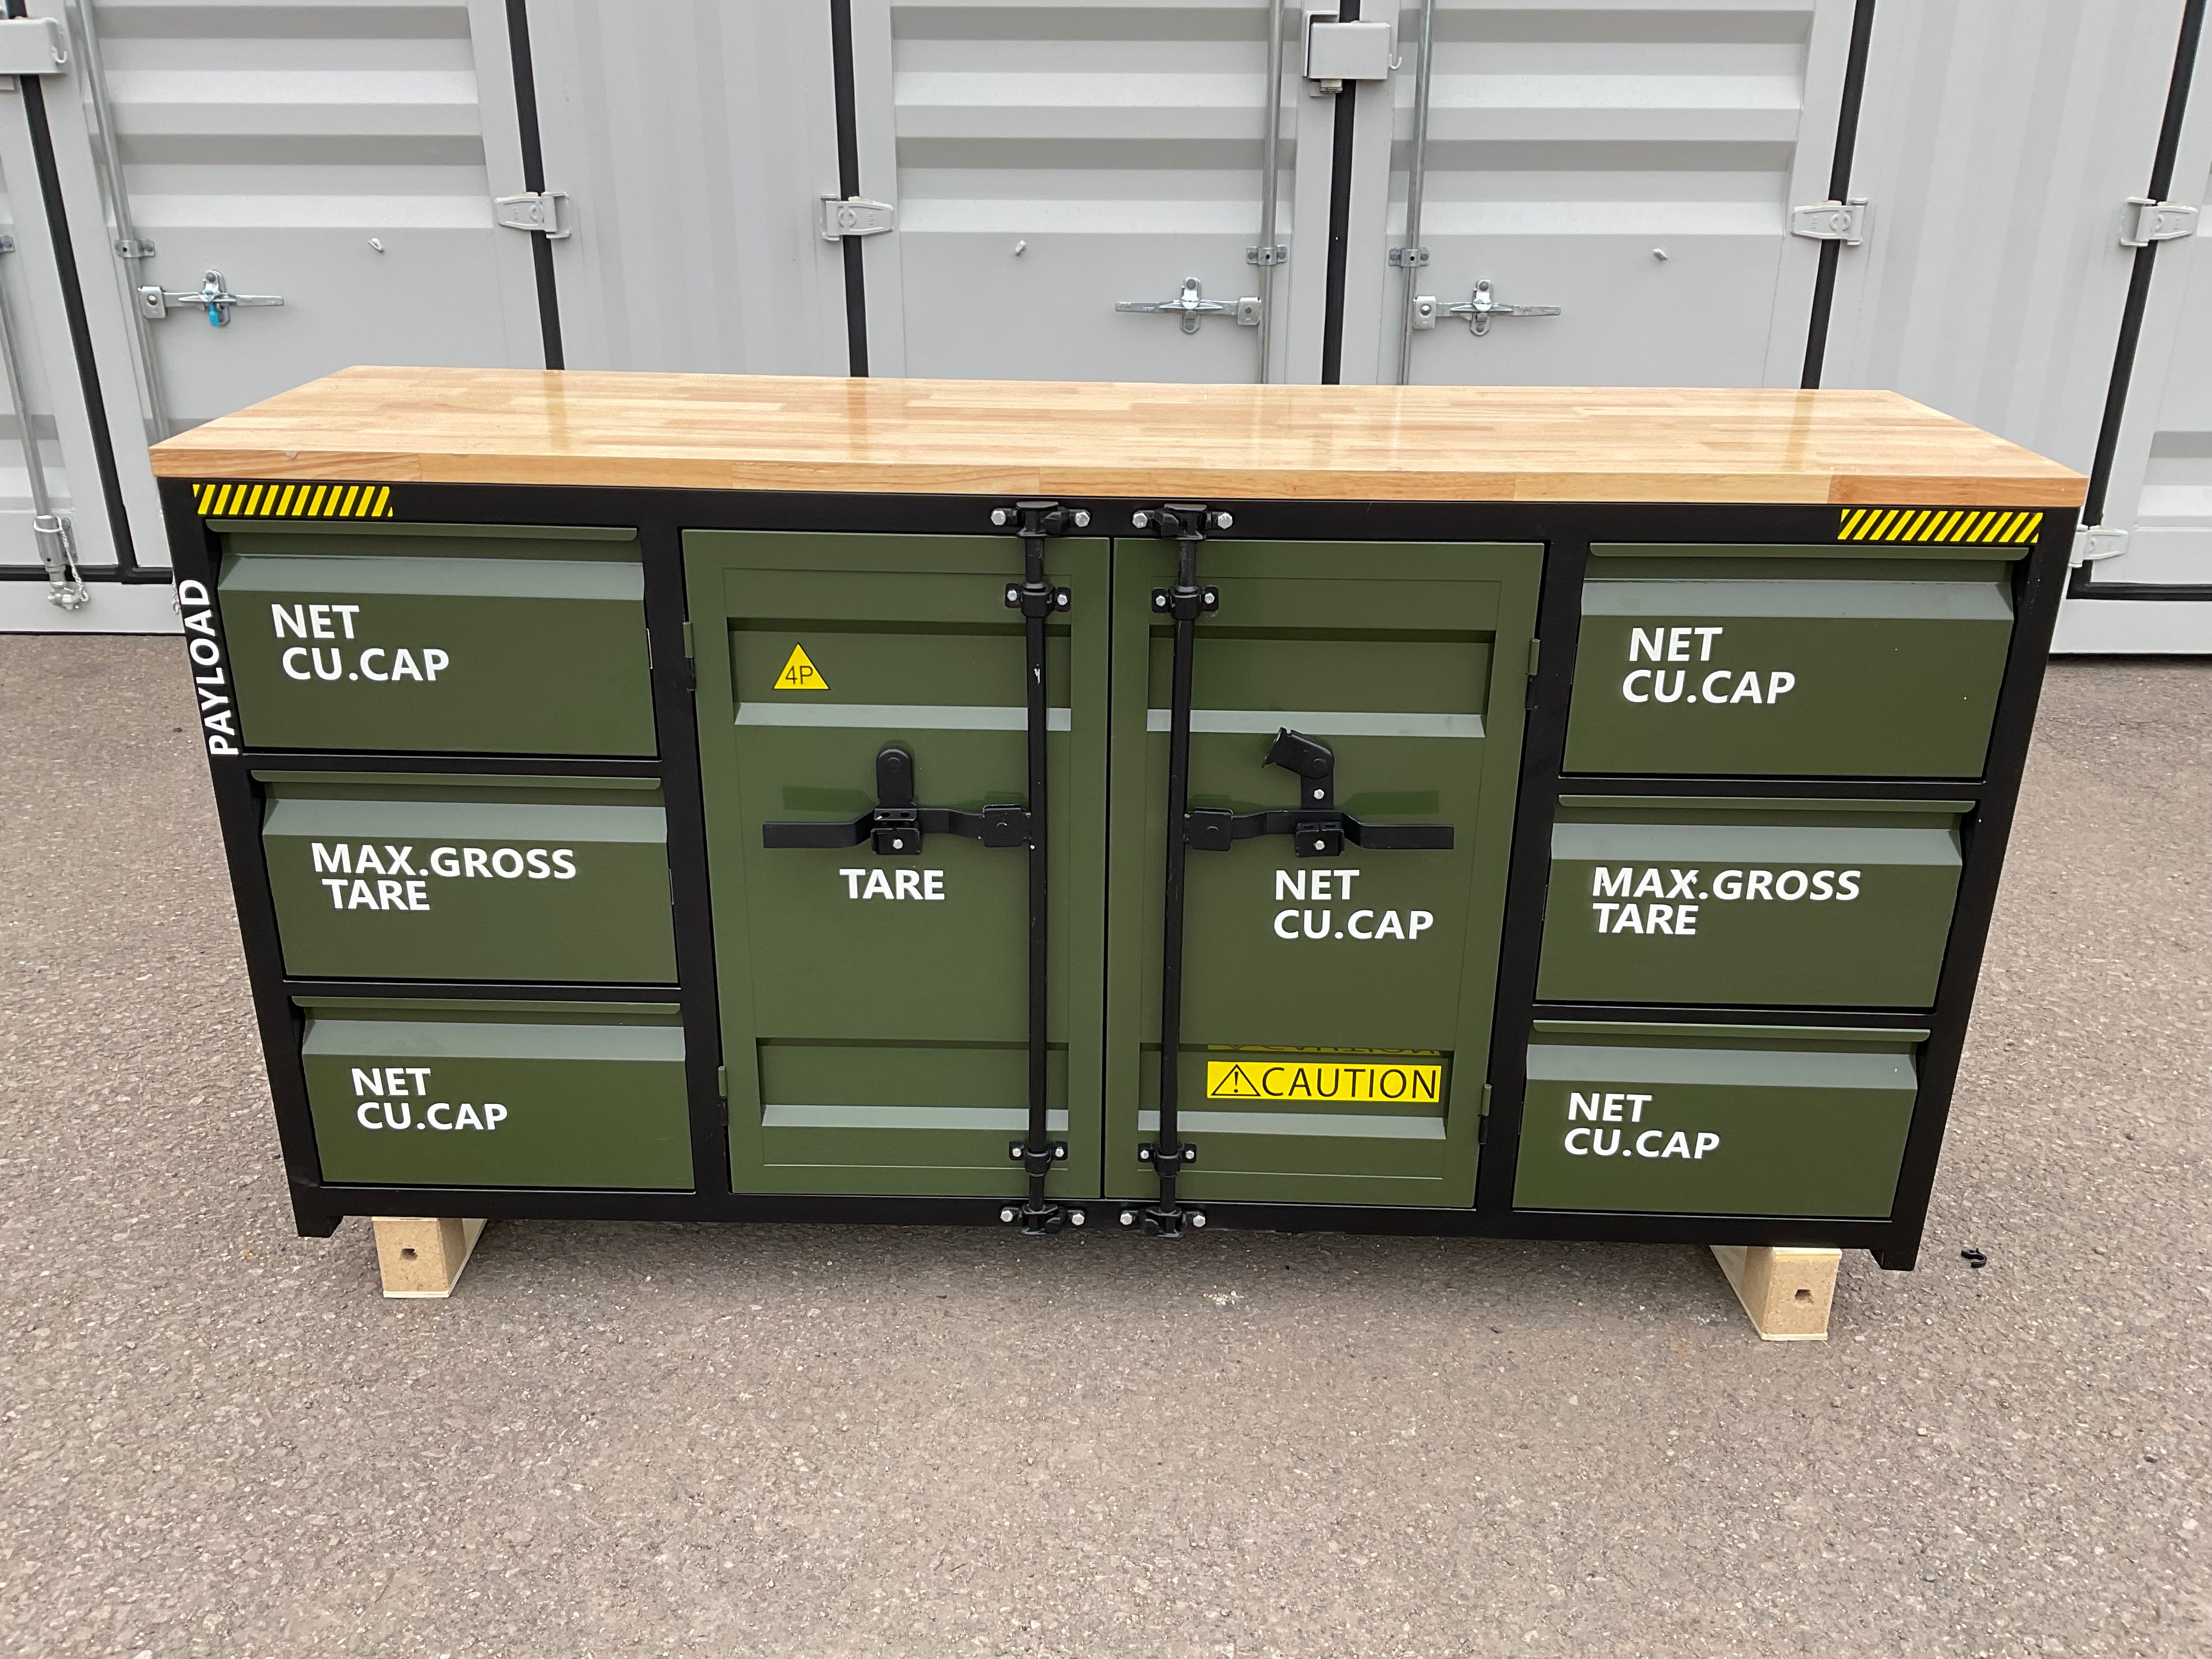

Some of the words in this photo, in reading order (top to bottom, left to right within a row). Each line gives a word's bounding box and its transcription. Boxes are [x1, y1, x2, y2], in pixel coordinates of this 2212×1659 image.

[271, 603, 360, 639] NET
[1629, 627, 1723, 662] NET
[178, 579, 239, 757] PAYLOAD
[282, 647, 449, 681] CU.CAP
[785, 665, 814, 685] 4P
[1622, 669, 1795, 704] CU.CAP
[311, 842, 576, 879] MAX.GROSS
[321, 879, 430, 911] TARE
[839, 868, 945, 900] TARE
[1274, 869, 1360, 900] NET
[1592, 867, 1861, 901] MAX.GROSS
[1273, 909, 1434, 940] CU.CAP
[1592, 902, 1699, 935] TARE
[351, 1068, 431, 1096] NET
[1262, 1067, 1436, 1099] CAUTION
[357, 1102, 507, 1130] CU.CAP
[1568, 1092, 1652, 1122] NET
[1564, 1127, 1720, 1159] CU.CAP
